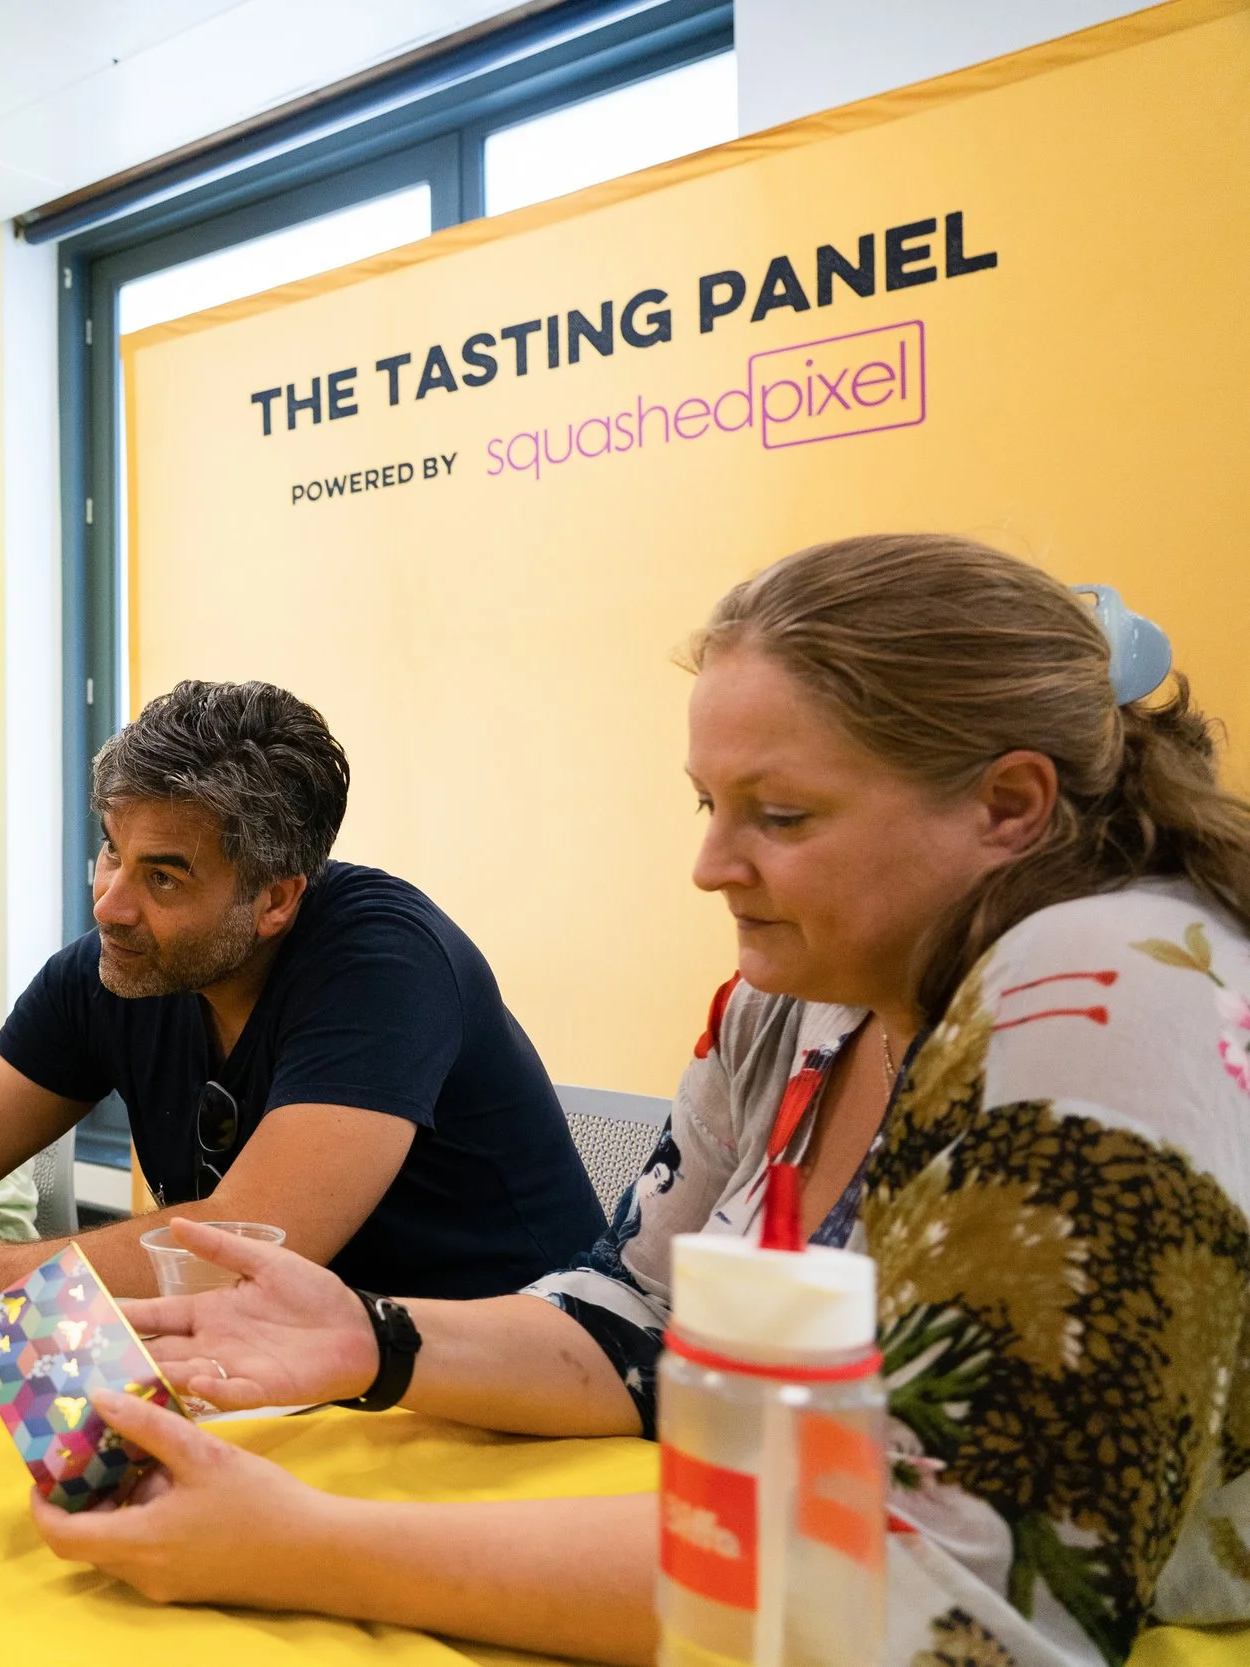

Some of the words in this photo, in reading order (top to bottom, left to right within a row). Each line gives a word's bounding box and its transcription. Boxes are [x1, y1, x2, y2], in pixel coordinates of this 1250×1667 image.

[251, 367, 358, 436] THE
[375, 288, 673, 406] TASTING
[699, 210, 999, 335] PANEL
[291, 462, 415, 505] POWERED
[422, 452, 458, 479] BY
